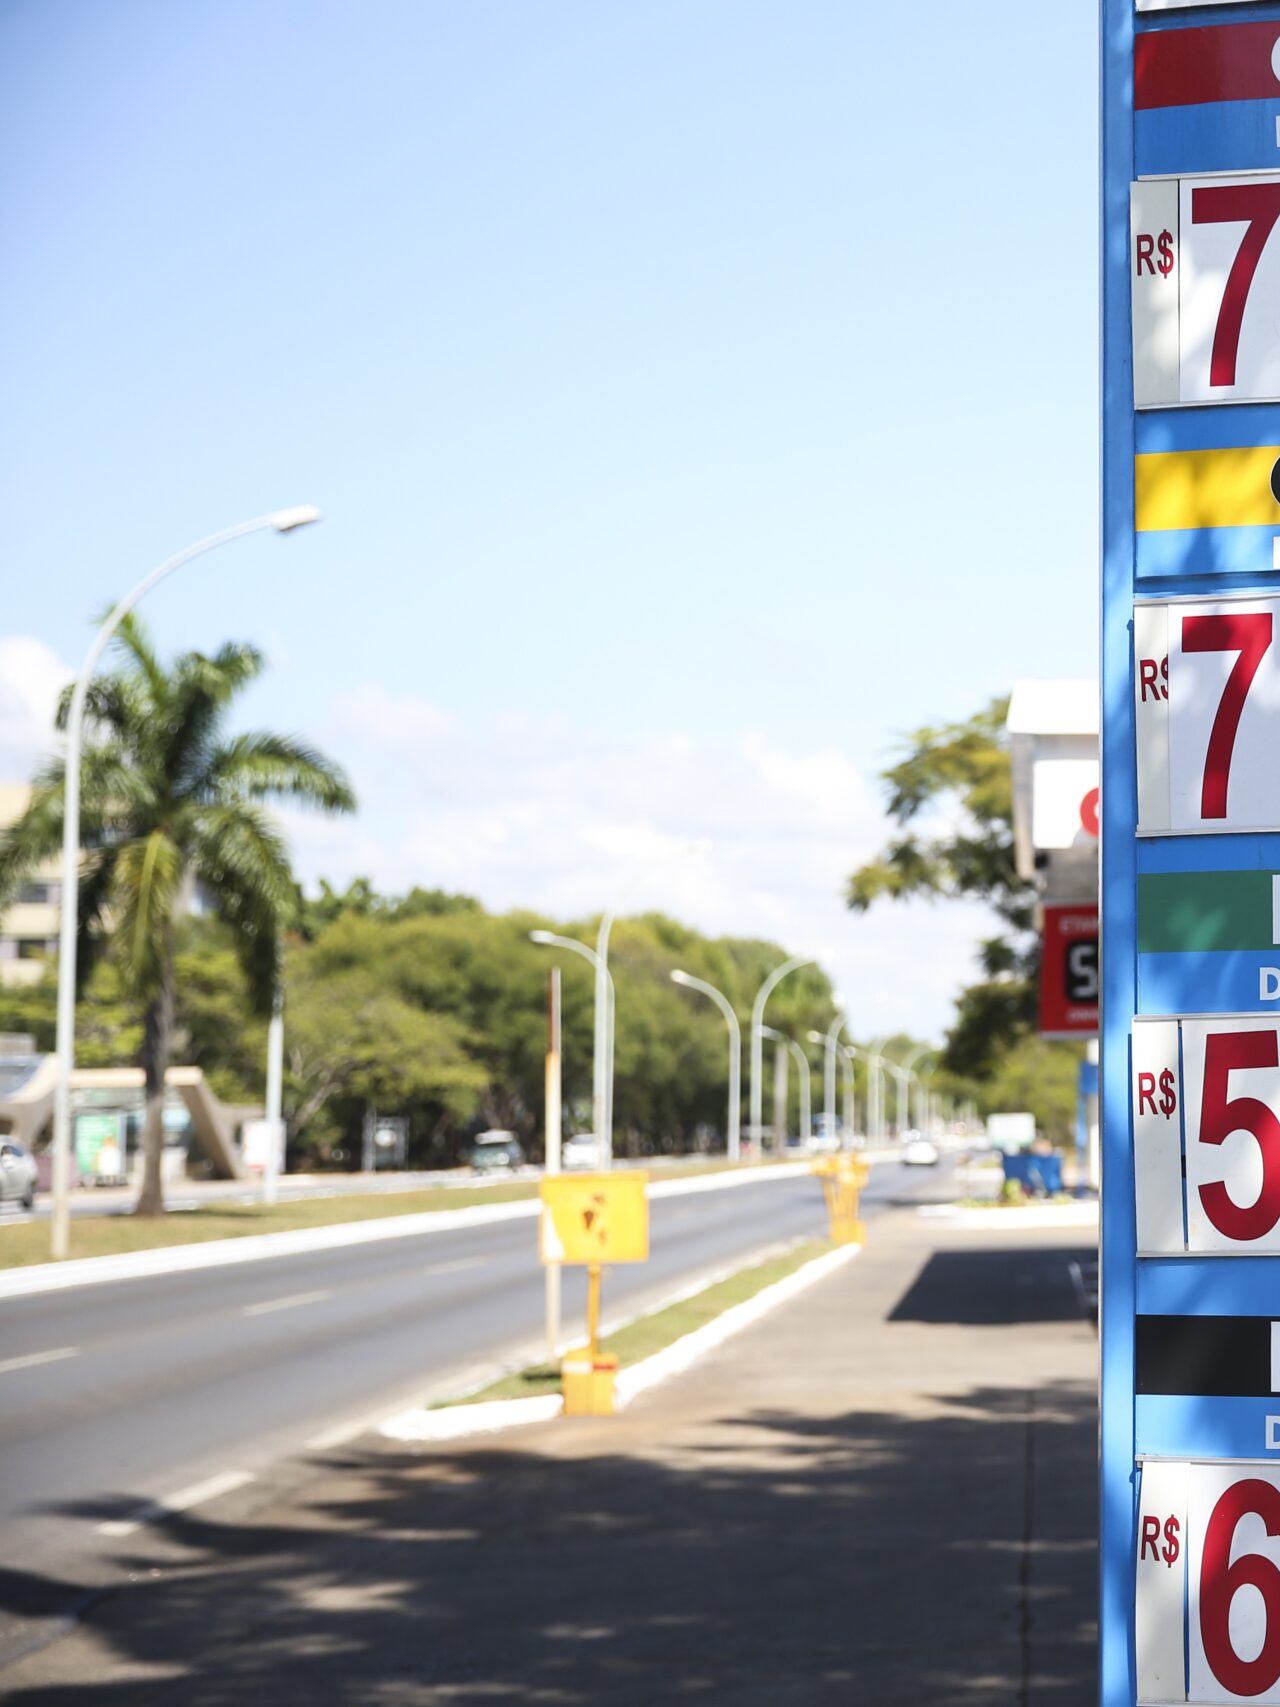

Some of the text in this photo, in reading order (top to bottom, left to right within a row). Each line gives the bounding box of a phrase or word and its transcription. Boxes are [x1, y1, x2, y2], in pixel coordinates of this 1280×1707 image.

[1136, 229, 1175, 279] R$
[1138, 1067, 1177, 1120] R$
[1140, 1513, 1181, 1568] R$
